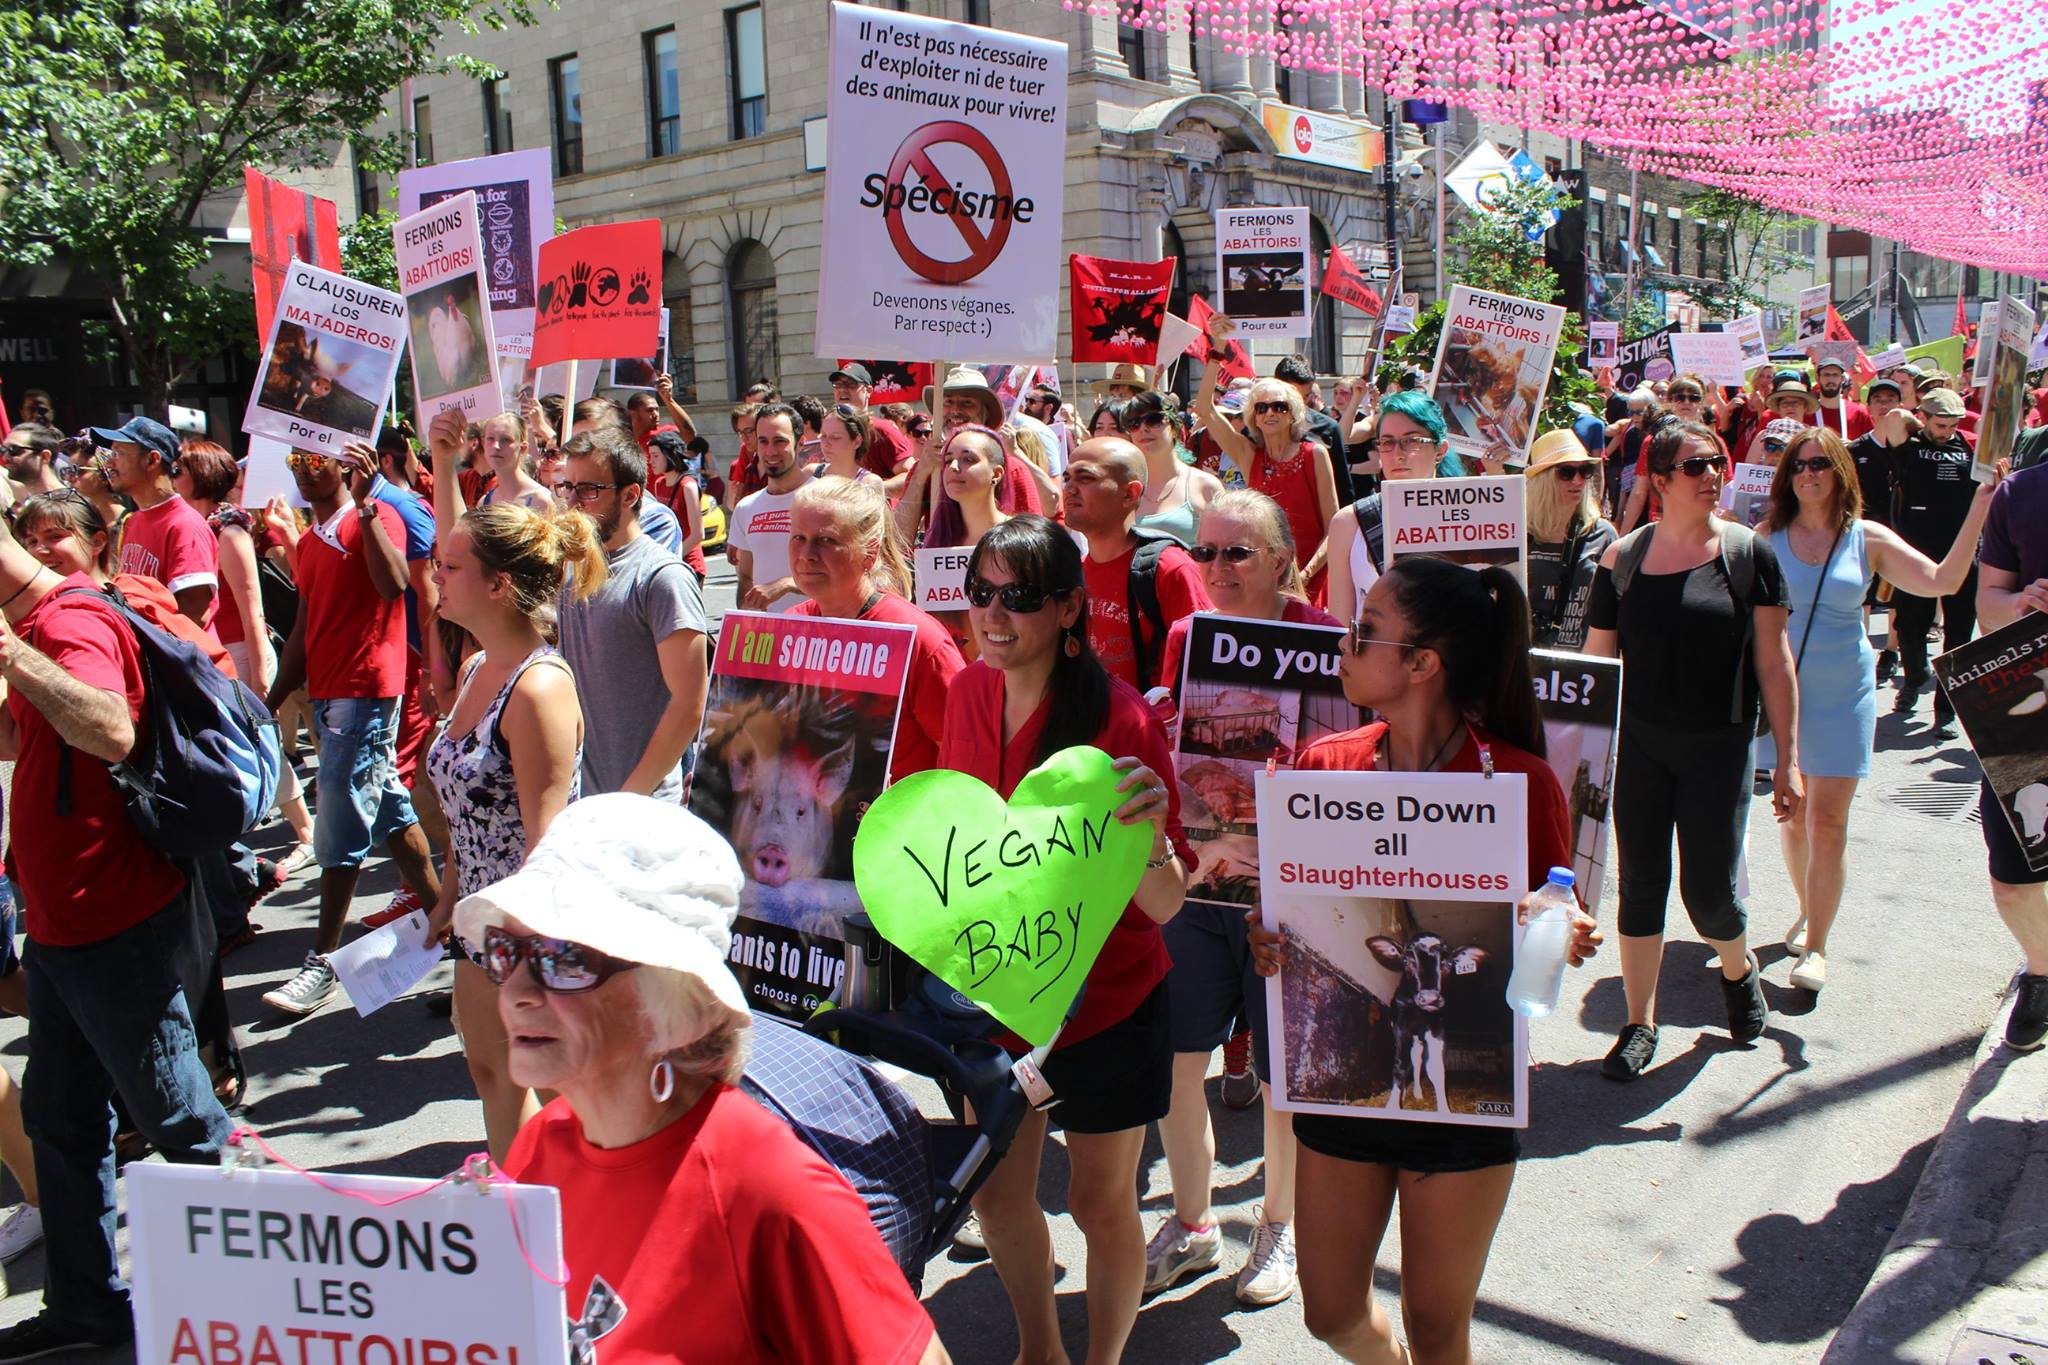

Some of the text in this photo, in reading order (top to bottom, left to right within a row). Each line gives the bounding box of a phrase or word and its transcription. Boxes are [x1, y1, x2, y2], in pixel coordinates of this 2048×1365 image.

[859, 21, 1048, 71] Il n'est pas nécessaire
[861, 49, 1045, 96] d'exploiter ni de tuer
[846, 75, 1056, 124] des animaux pour vivre!
[487, 189, 508, 203] for
[860, 173, 1034, 223] Spécisme
[405, 210, 462, 248] FERMONS
[1229, 214, 1295, 227] FERMONS
[1253, 228, 1272, 236] LES
[427, 240, 444, 257] LES
[1223, 237, 1302, 249] ABATTOIRS!
[406, 246, 474, 287] ABATTOIRS!
[296, 273, 404, 318] CLAUSUREN
[873, 291, 1015, 317] Devenons véganes.
[1468, 294, 1545, 321] FERMONS
[332, 303, 360, 320] LOS
[1493, 312, 1515, 325] LES
[286, 305, 396, 350] MATADEROS!
[894, 314, 992, 338] Par respect :)
[1241, 321, 1288, 331] Pour eux
[1453, 315, 1540, 344] ABATTOIRS
[463, 394, 476, 411] lui
[289, 422, 332, 444] Por el
[1404, 486, 1504, 507] FERMONS
[754, 513, 767, 521] eat
[1442, 508, 1470, 521] LES
[1395, 523, 1515, 544] ABATTOIRS!
[934, 555, 968, 570] FER
[926, 587, 964, 601] ABA
[728, 623, 889, 679] I am someone
[1211, 632, 1342, 680] Do you
[1947, 643, 2033, 691] Animals
[1532, 670, 1595, 706] als?
[1287, 793, 1496, 824] Close Down
[1374, 832, 1407, 856] all
[903, 810, 1112, 907] VEGAN
[1279, 862, 1509, 891] Slaughterhouses
[731, 933, 845, 988] ants to live
[954, 901, 1083, 1003] BABY
[753, 982, 823, 1011] choose ve
[1477, 1103, 1510, 1113] KARA
[186, 1205, 478, 1275] FERMONS
[293, 1277, 375, 1320] LES
